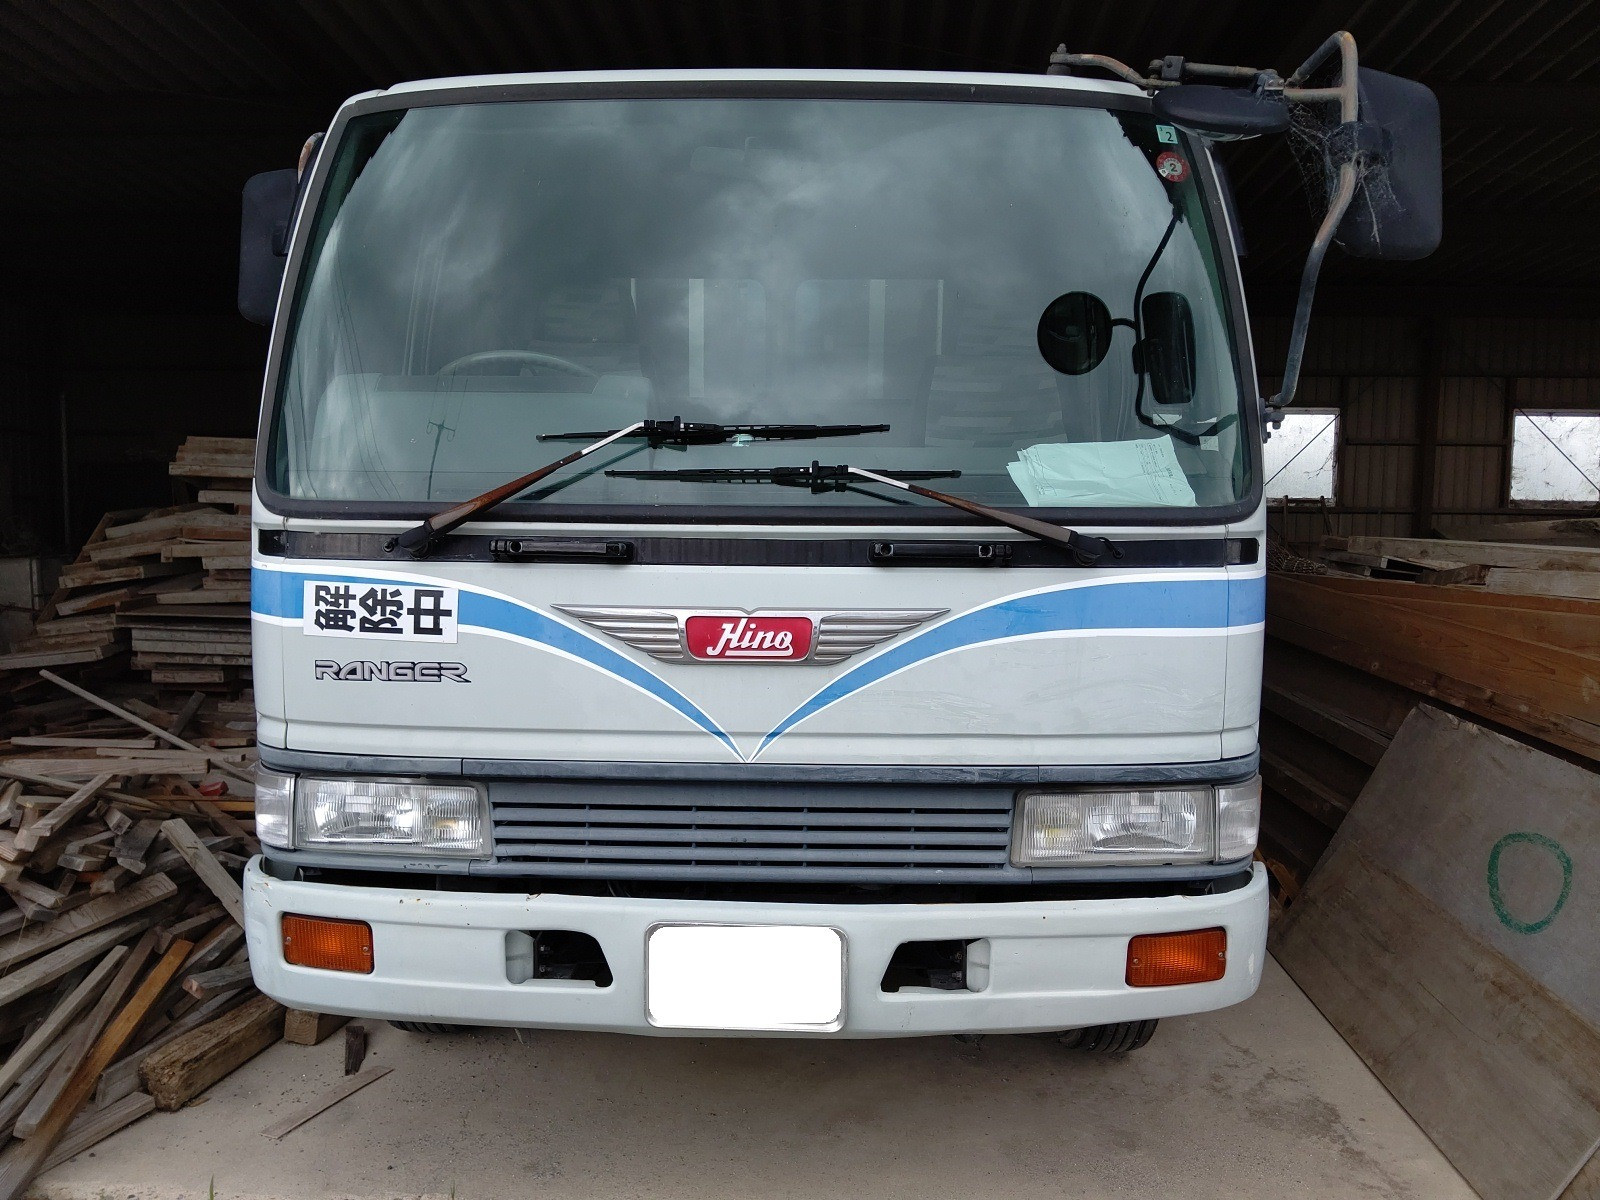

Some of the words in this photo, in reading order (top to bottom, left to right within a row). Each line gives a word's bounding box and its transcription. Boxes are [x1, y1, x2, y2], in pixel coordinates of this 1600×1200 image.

[1165, 131, 1174, 142] 2
[1169, 162, 1178, 172] 2
[314, 584, 453, 636] 解除中
[706, 618, 794, 656] Hino
[315, 659, 471, 683] RANGER
